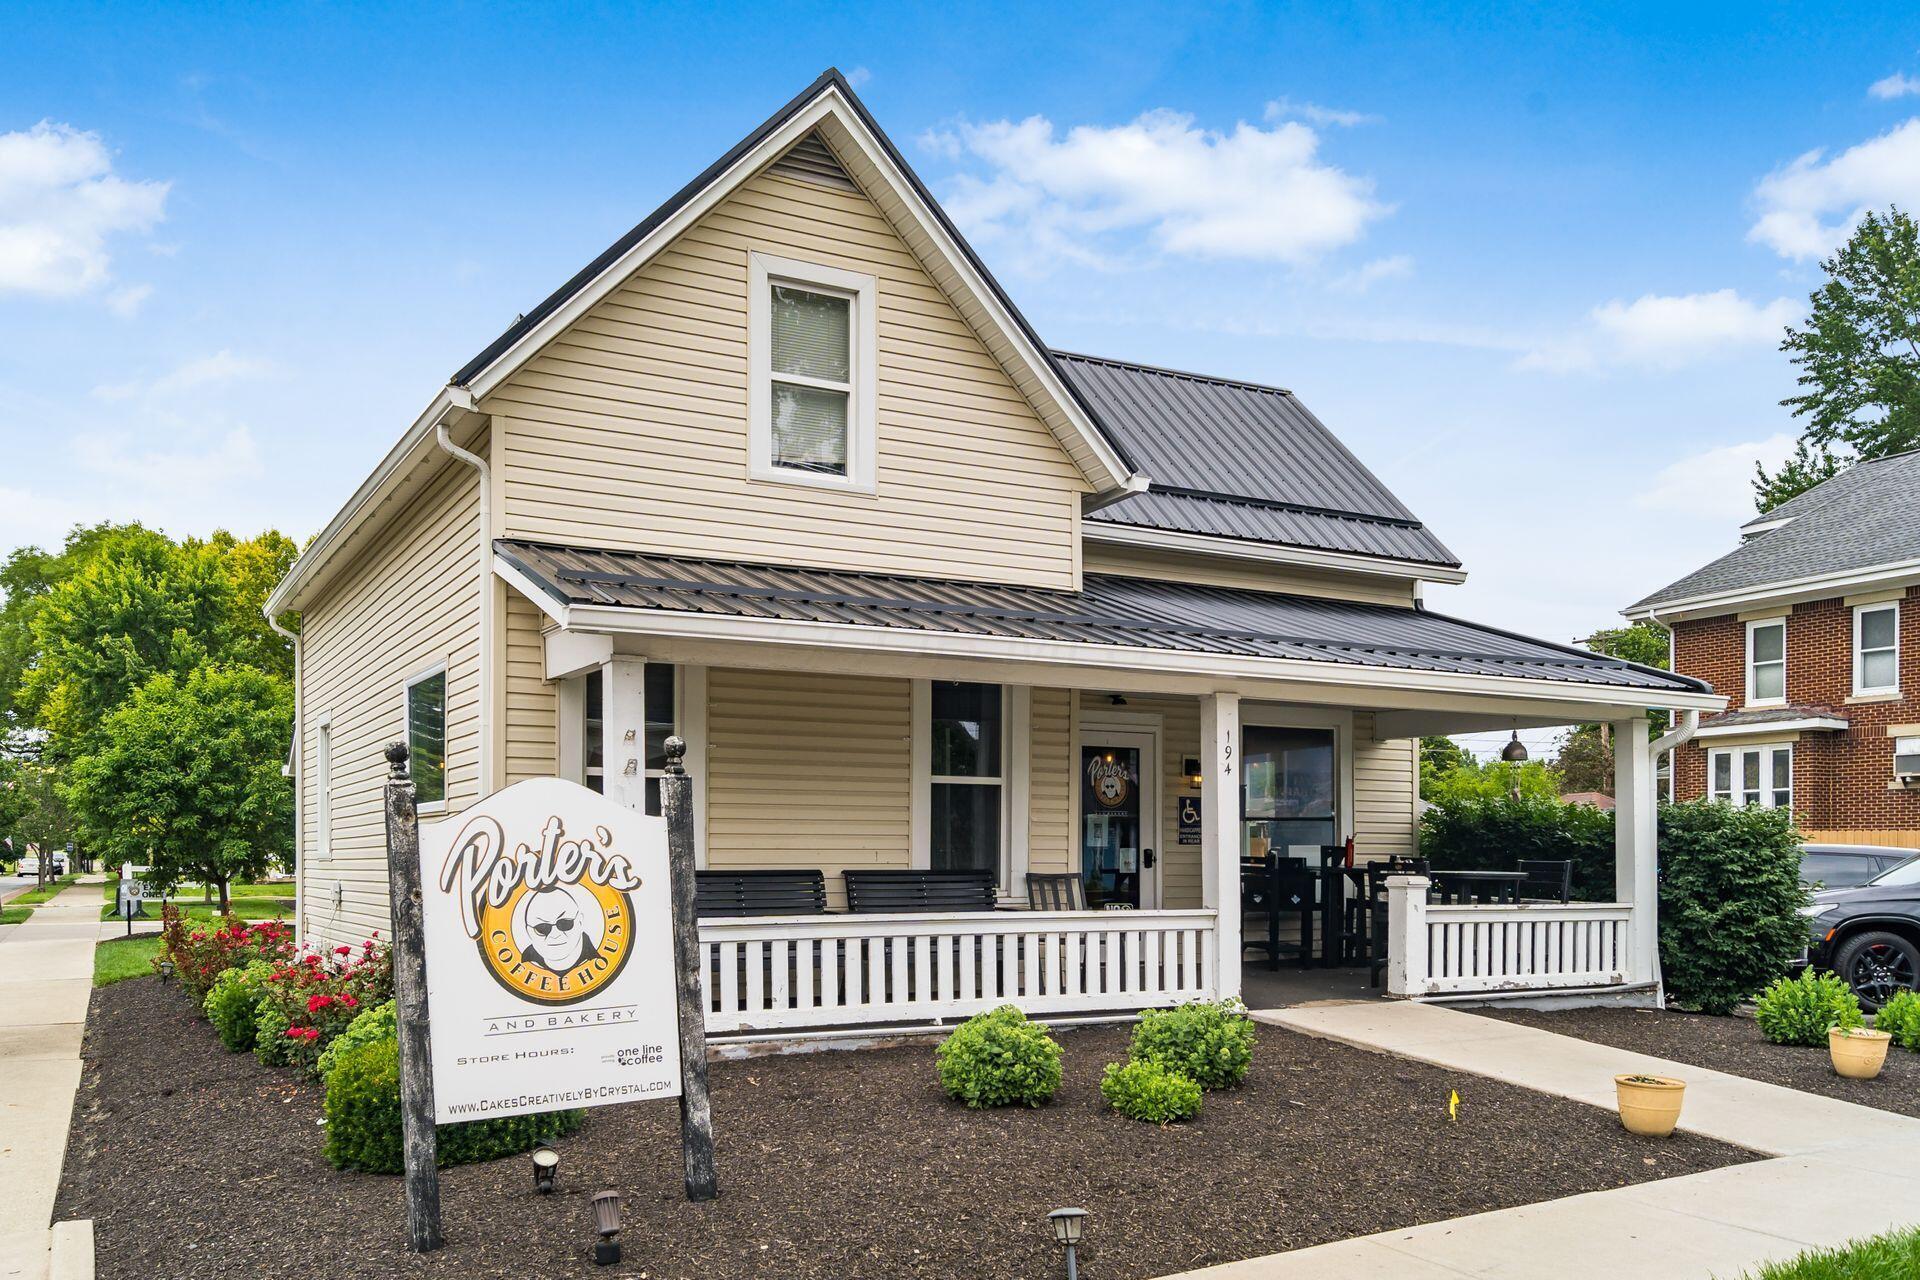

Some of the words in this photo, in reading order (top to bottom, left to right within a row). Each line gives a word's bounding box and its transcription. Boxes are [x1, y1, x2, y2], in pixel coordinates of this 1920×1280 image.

[1224, 729, 1232, 776] 194
[440, 815, 642, 940] Porter's
[491, 930, 571, 991] COFFEE
[578, 905, 622, 985] HOUSE
[489, 1019, 535, 1032] AND
[548, 1009, 637, 1026] BAKERY
[617, 1047, 639, 1057] one
[642, 1044, 663, 1055] line
[626, 1054, 663, 1066] coffee
